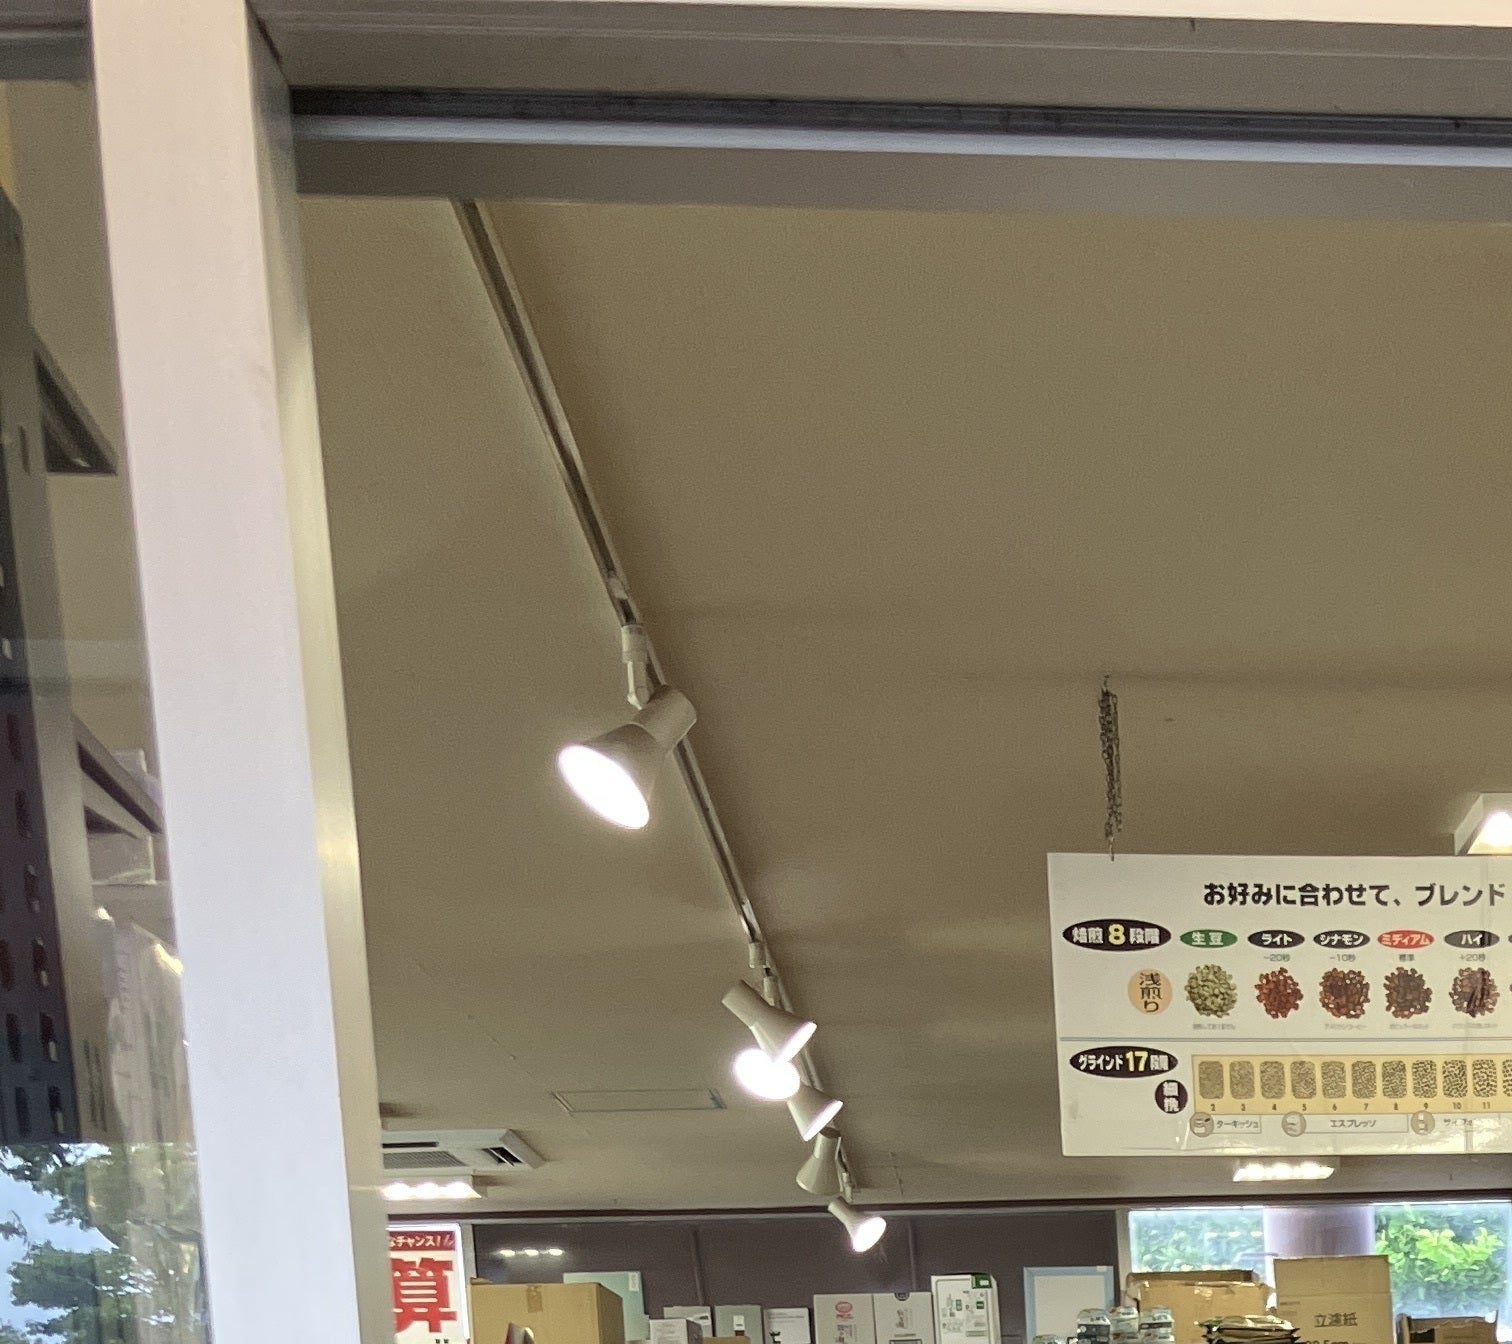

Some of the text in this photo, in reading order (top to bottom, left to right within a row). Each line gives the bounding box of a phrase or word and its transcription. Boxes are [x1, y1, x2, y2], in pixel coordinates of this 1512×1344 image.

[1192, 932, 1224, 947] 生豆
[1261, 933, 1293, 947] ライト
[1319, 933, 1364, 947] シナモン
[1382, 933, 1431, 946] ミディアム
[1461, 932, 1484, 945] ハイ
[1139, 971, 1162, 1013] 浅煎り
